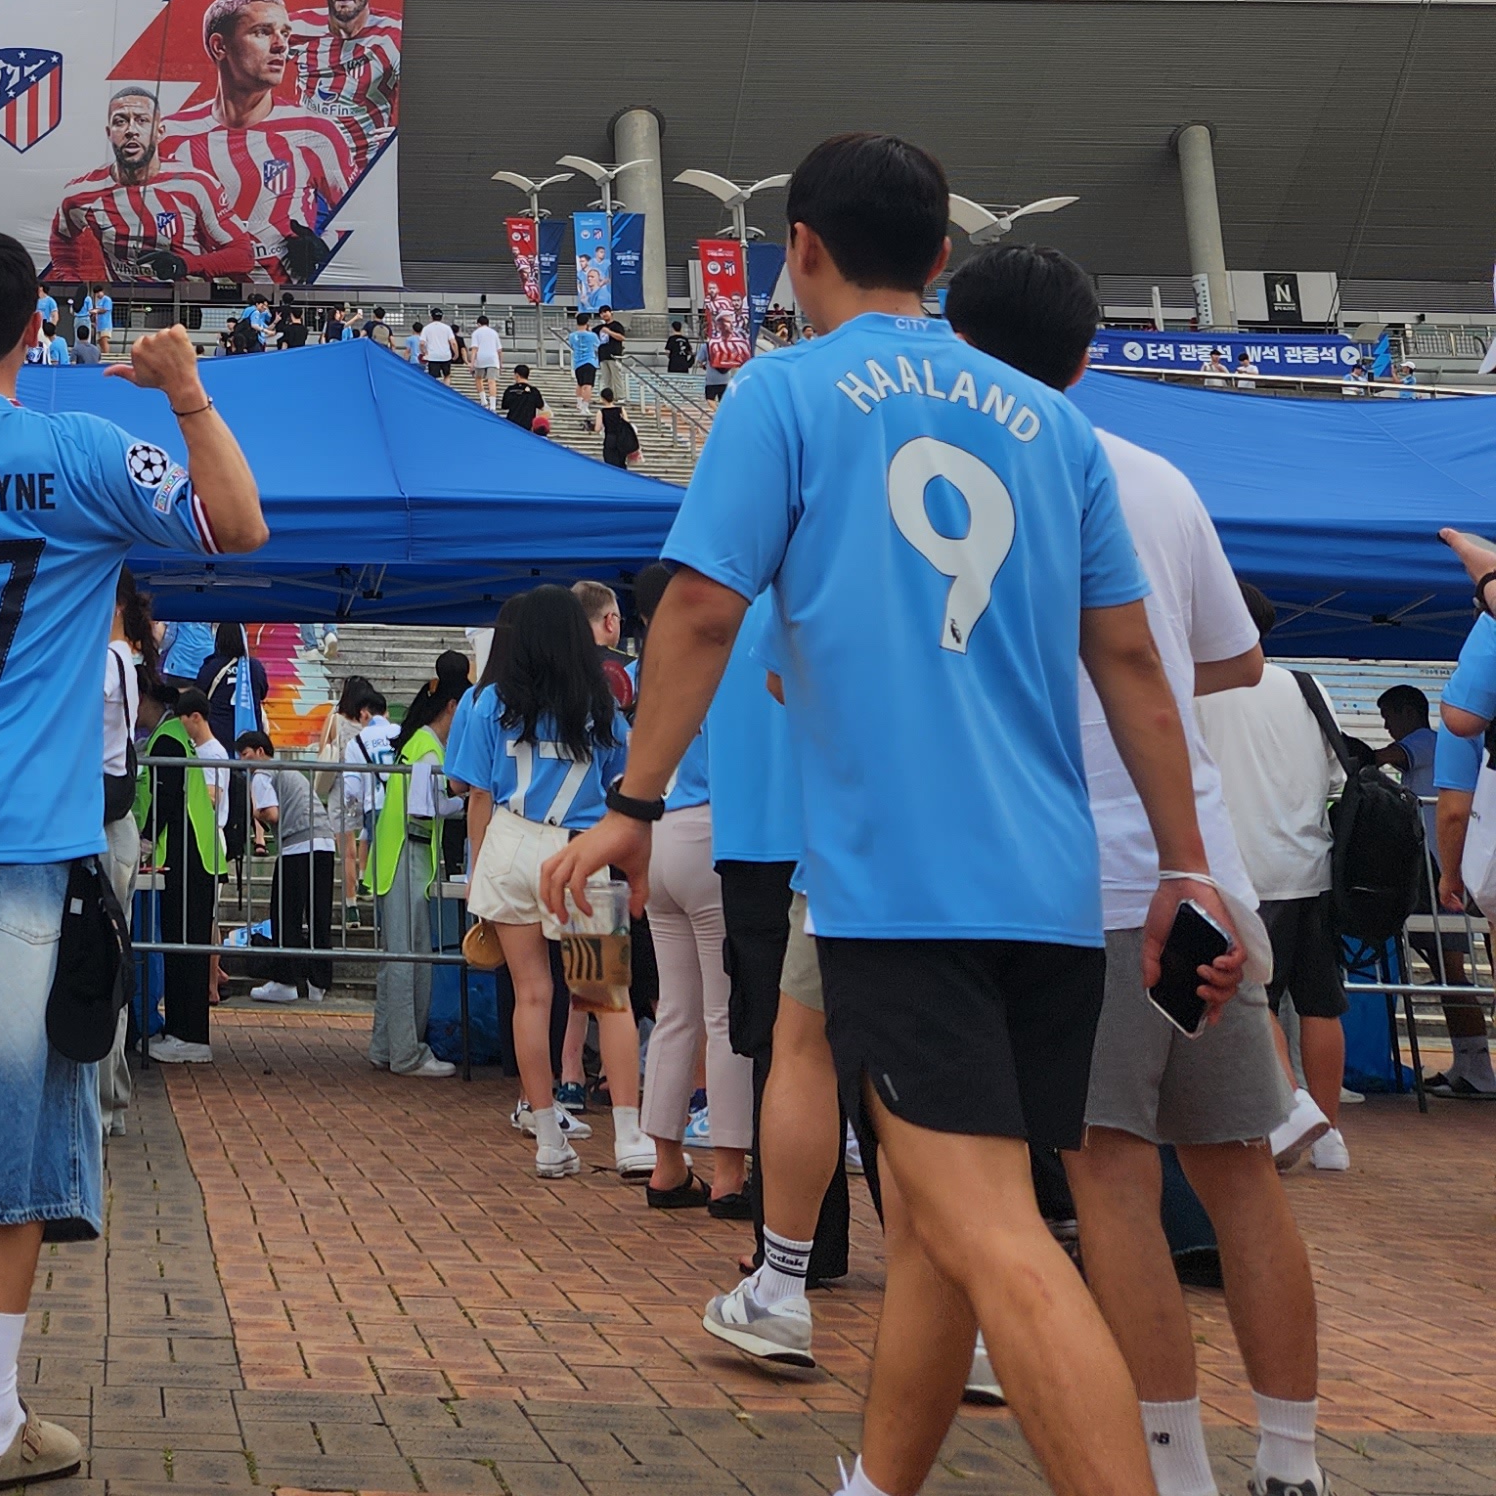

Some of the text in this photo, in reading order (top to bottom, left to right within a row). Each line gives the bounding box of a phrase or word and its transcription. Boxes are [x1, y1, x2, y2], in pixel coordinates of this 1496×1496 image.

[1275, 284, 1292, 302] N
[896, 318, 931, 331] CITY
[1147, 344, 1175, 361] E석
[1246, 345, 1338, 364] W석 관중석
[836, 356, 1041, 443] HAALAND
[887, 435, 1017, 656] 9
[506, 739, 593, 826] 17
